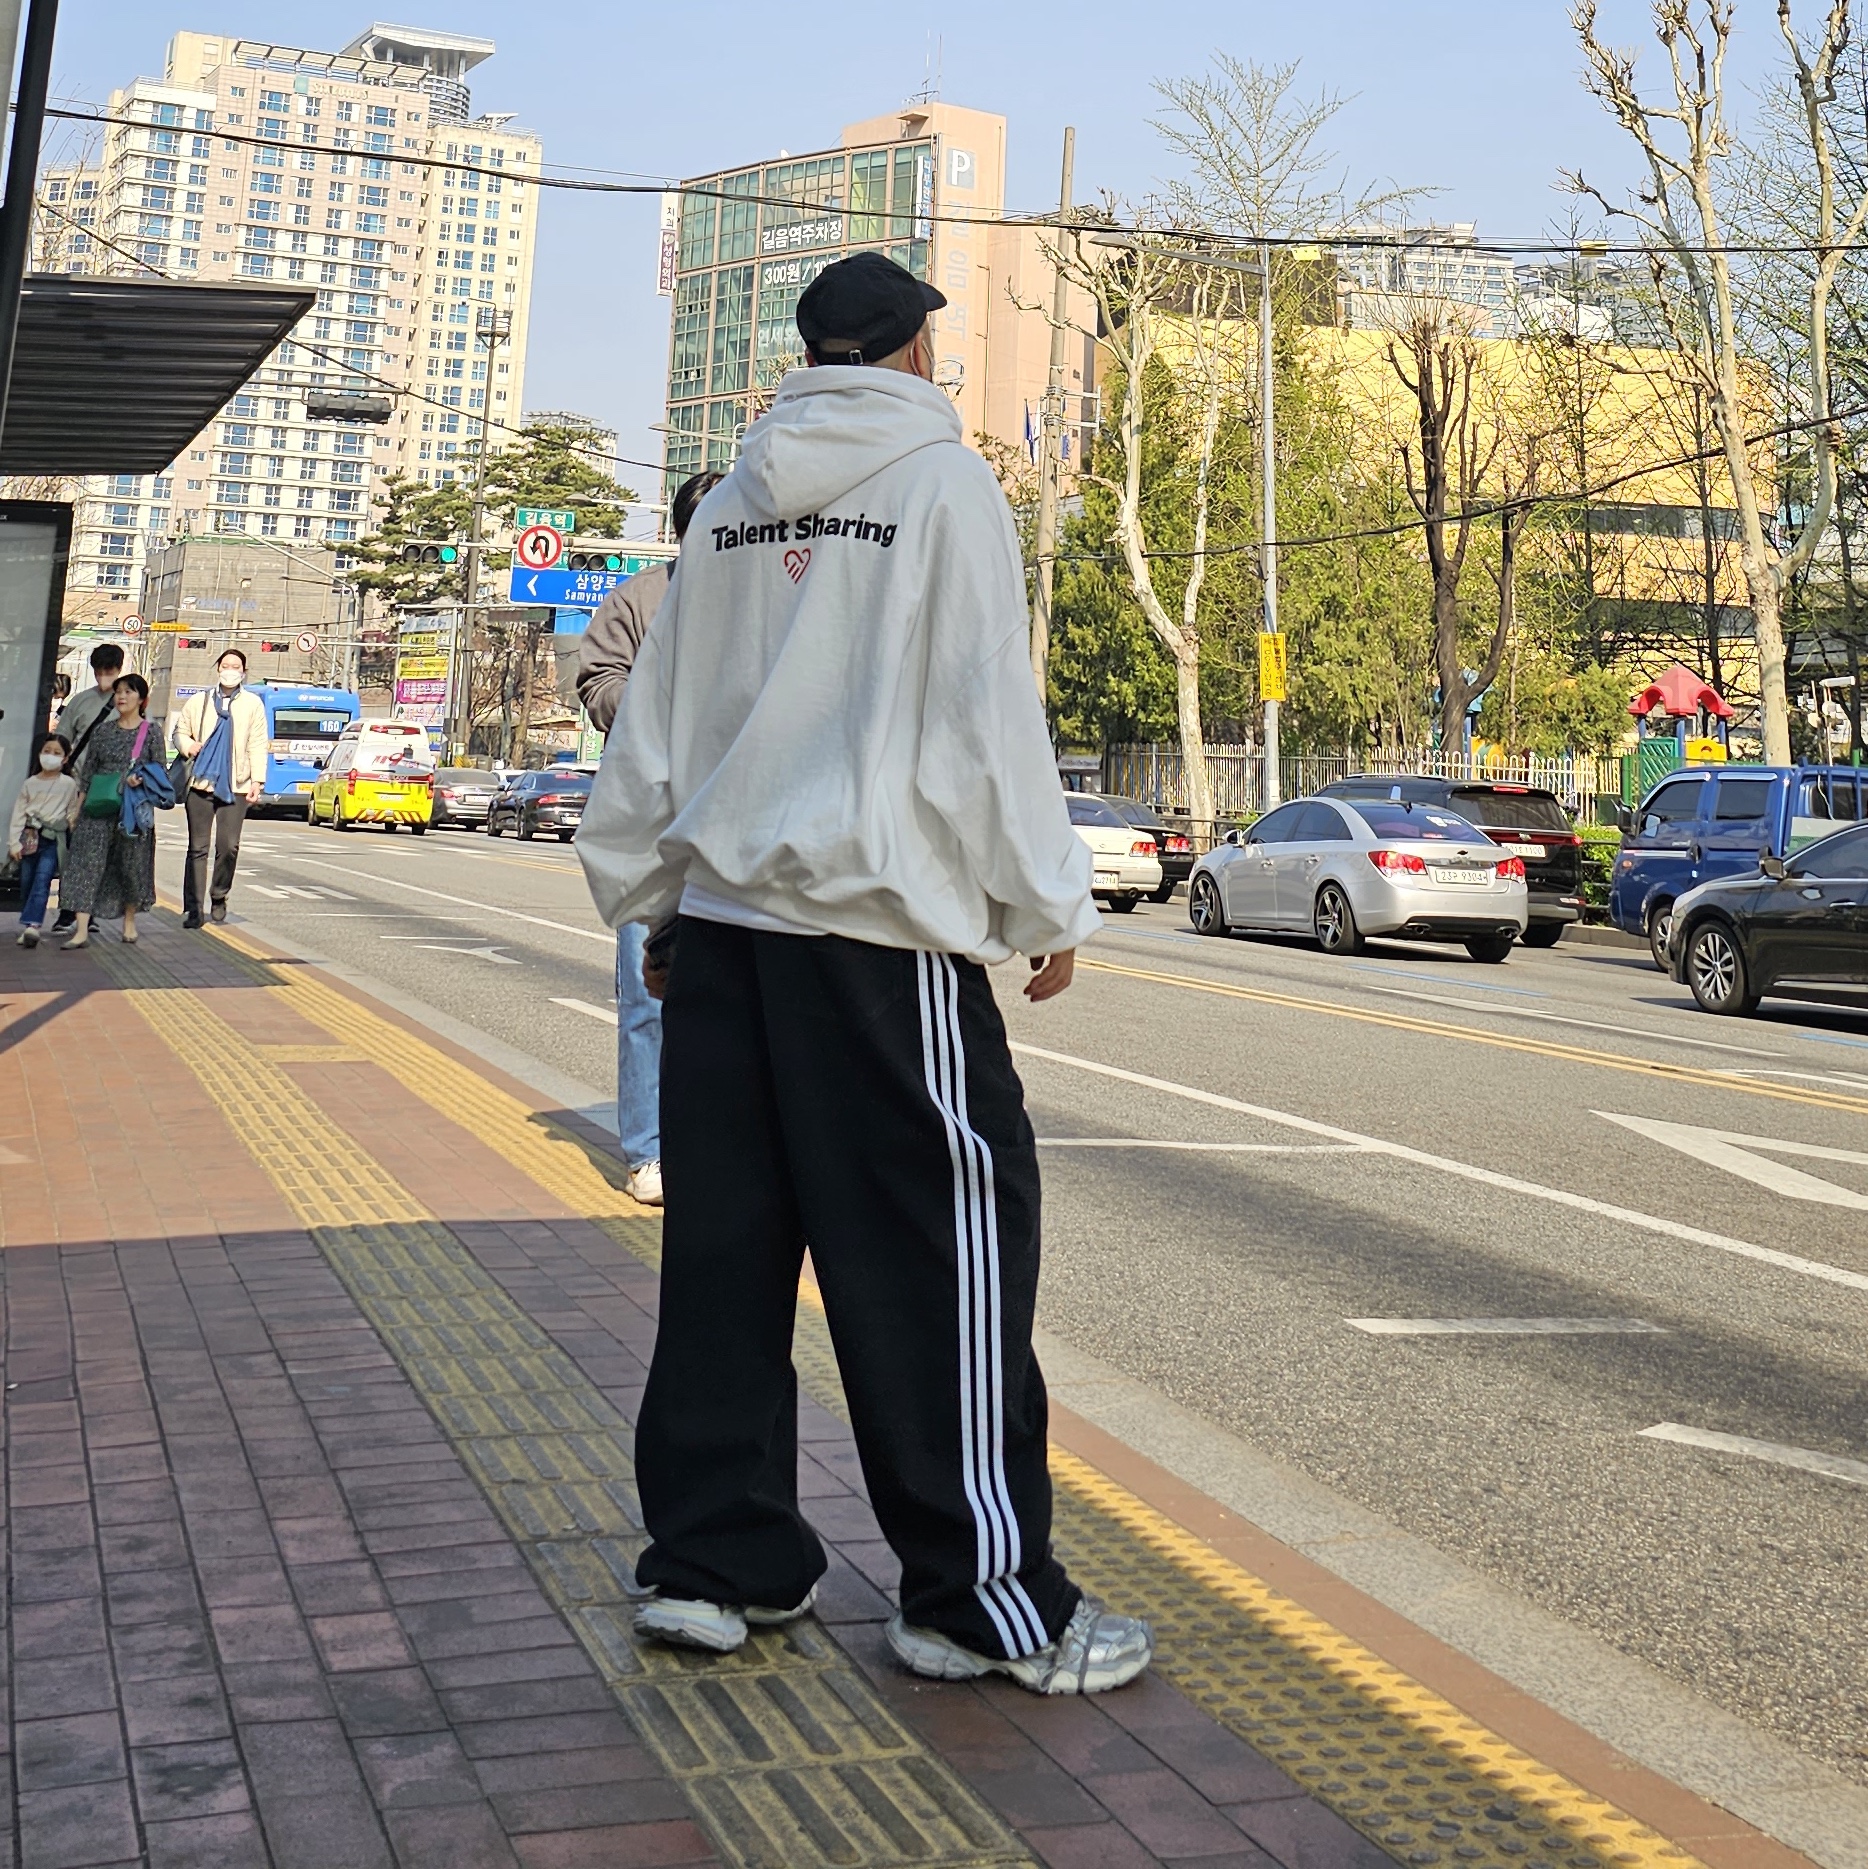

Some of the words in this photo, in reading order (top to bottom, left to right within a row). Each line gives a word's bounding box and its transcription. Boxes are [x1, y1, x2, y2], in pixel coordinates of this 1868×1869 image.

[952, 149, 971, 186] P
[666, 206, 675, 228] 치과
[762, 220, 843, 250] 길음역주차장
[525, 511, 567, 528] 길음역
[711, 519, 789, 551] Talent
[794, 512, 898, 548] Sharing
[575, 573, 617, 591] 삼양로
[565, 588, 606, 604] Samyan
[126, 619, 139, 630] 50
[321, 720, 340, 732] 160
